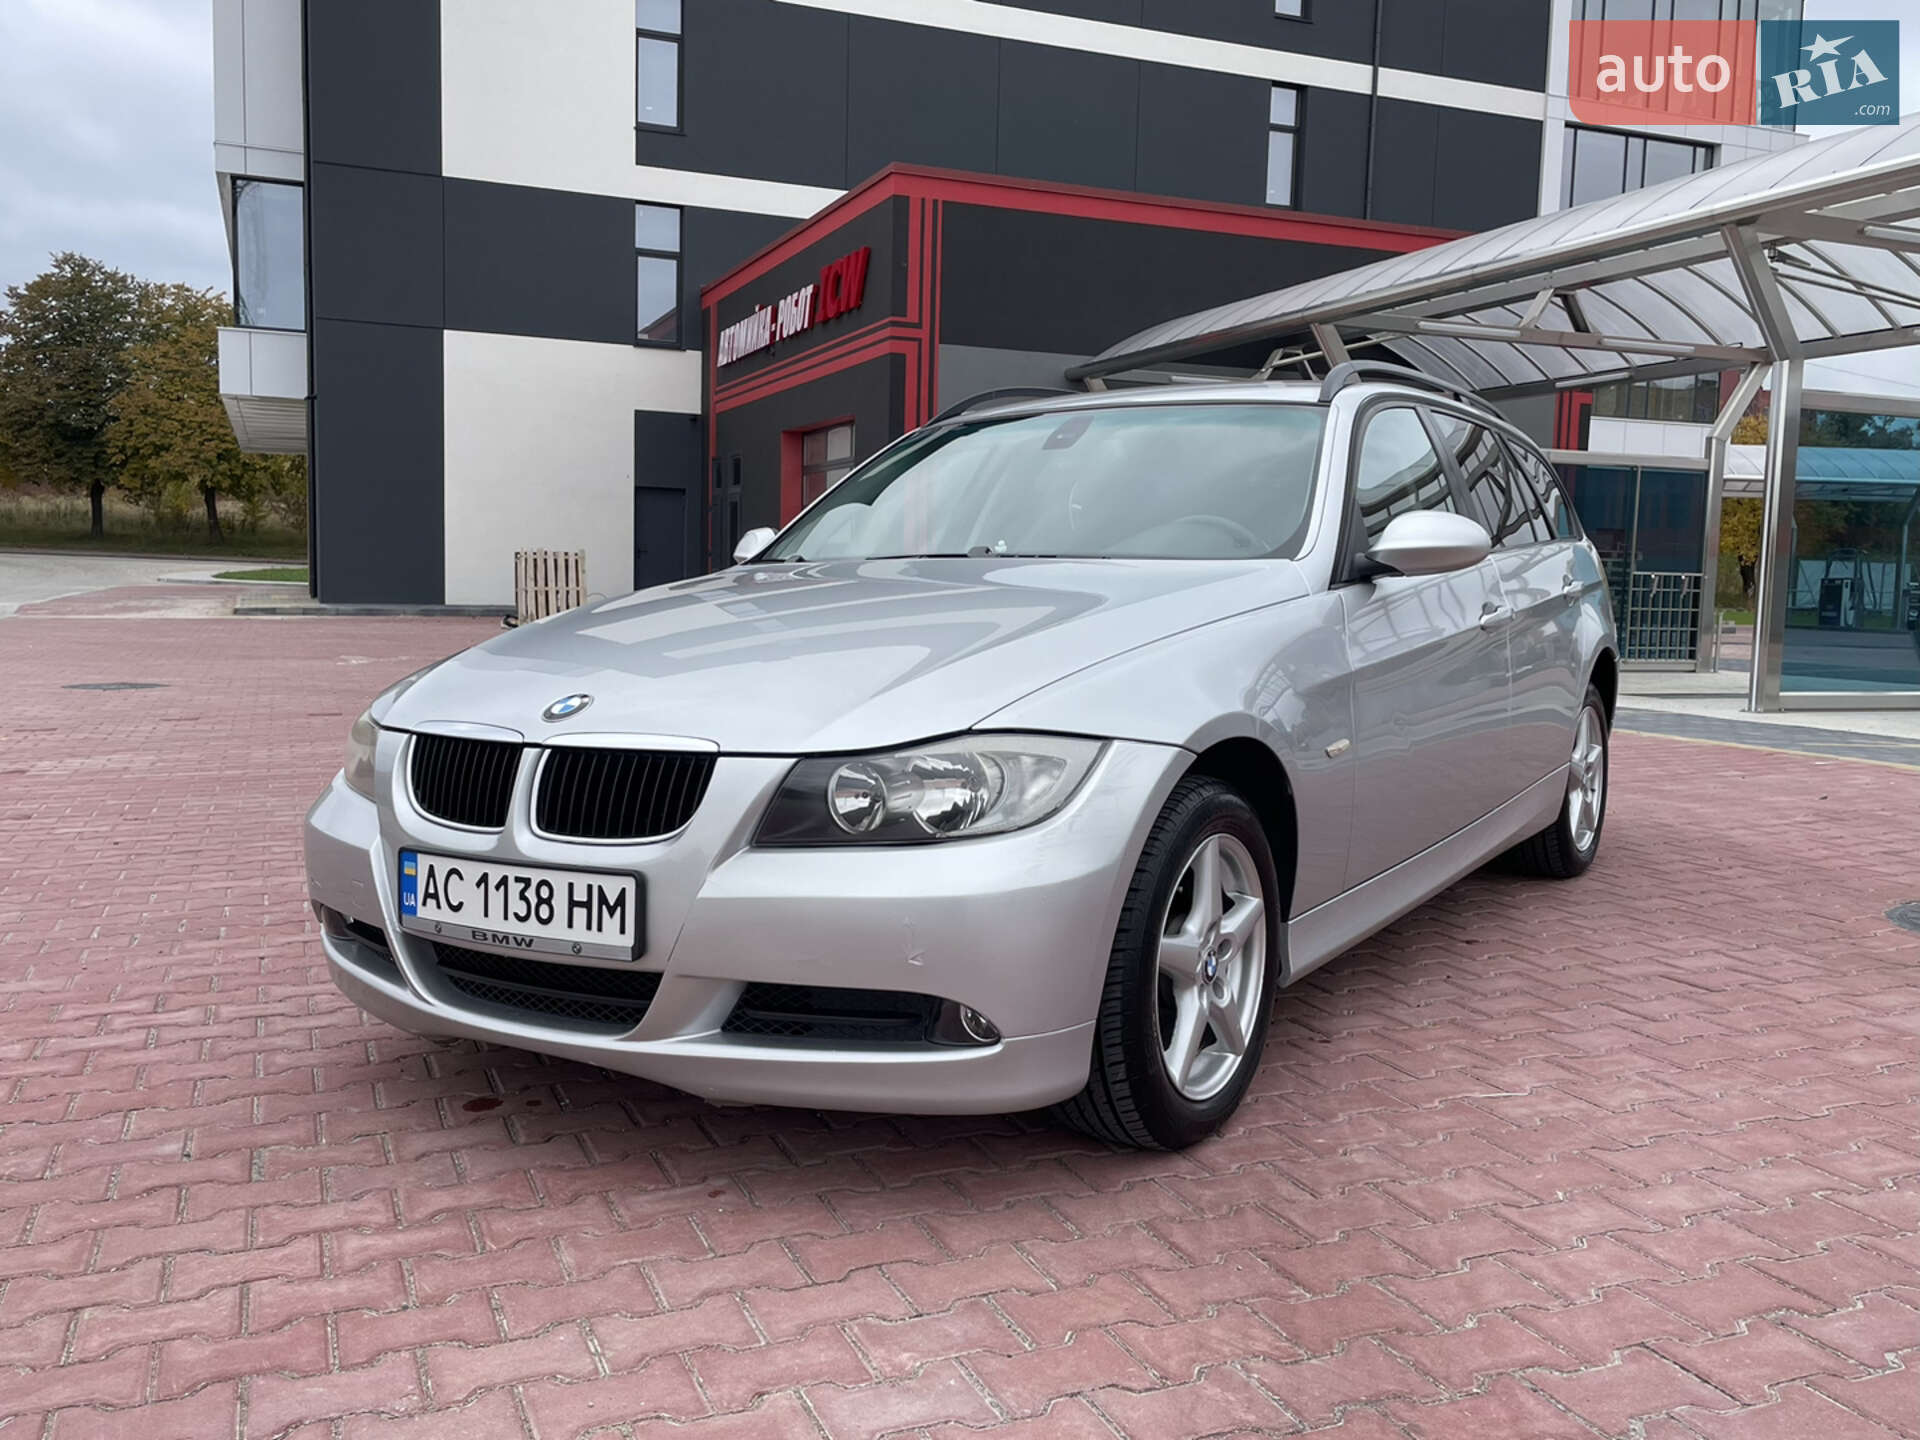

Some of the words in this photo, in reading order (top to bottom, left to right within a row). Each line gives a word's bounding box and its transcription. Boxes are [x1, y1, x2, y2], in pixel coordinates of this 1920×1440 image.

[403, 892, 416, 907] UA
[422, 864, 464, 913] AC
[475, 872, 555, 926] 1138
[567, 881, 627, 935] HM
[471, 930, 534, 948] BMW
